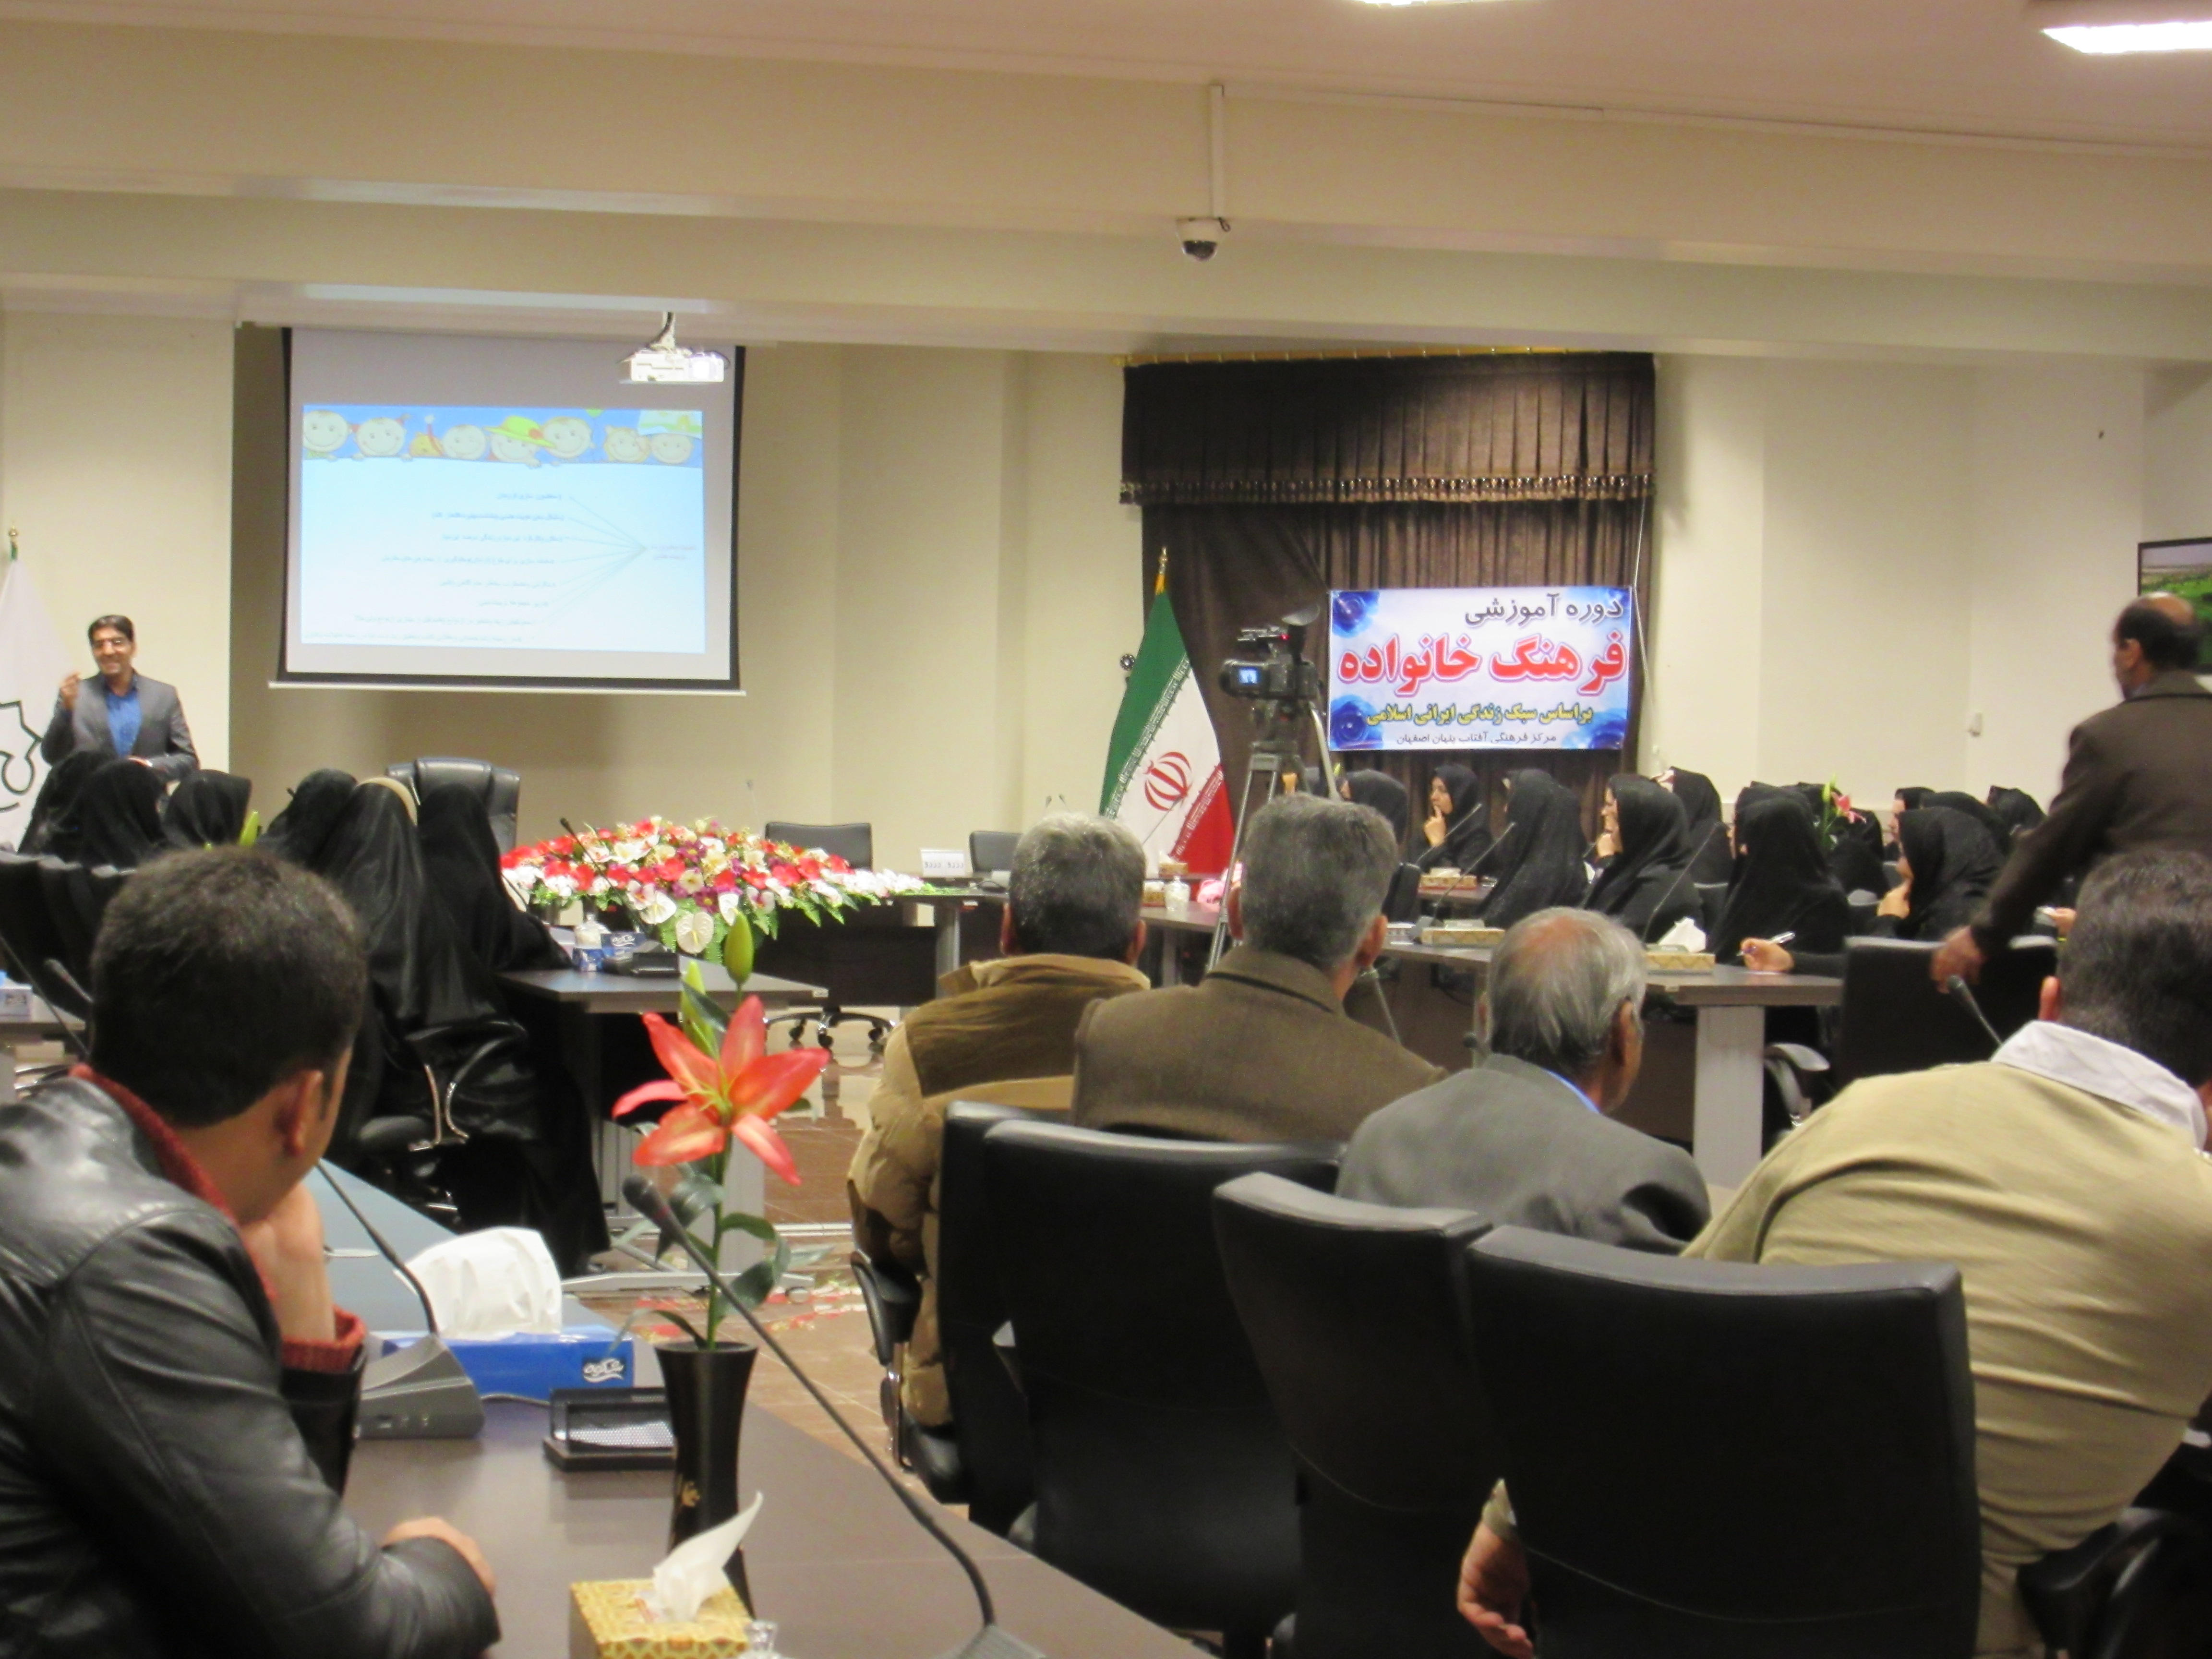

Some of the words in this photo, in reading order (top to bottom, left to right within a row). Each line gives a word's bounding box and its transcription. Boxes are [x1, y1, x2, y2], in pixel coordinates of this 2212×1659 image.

[1466, 593, 1559, 626] آموزشی
[1566, 601, 1623, 624] دوره
[1338, 633, 1482, 695] خانواده
[1489, 630, 1626, 694] فرهنگ
[1367, 703, 1412, 726] اسلامی
[1414, 703, 1456, 726] ایرانی
[1457, 702, 1503, 725] زندگی
[1505, 703, 1538, 724] سبک
[1397, 733, 1430, 745] اصفهان
[1491, 732, 1528, 744] فرهنگی
[1531, 733, 1556, 744] مرکز
